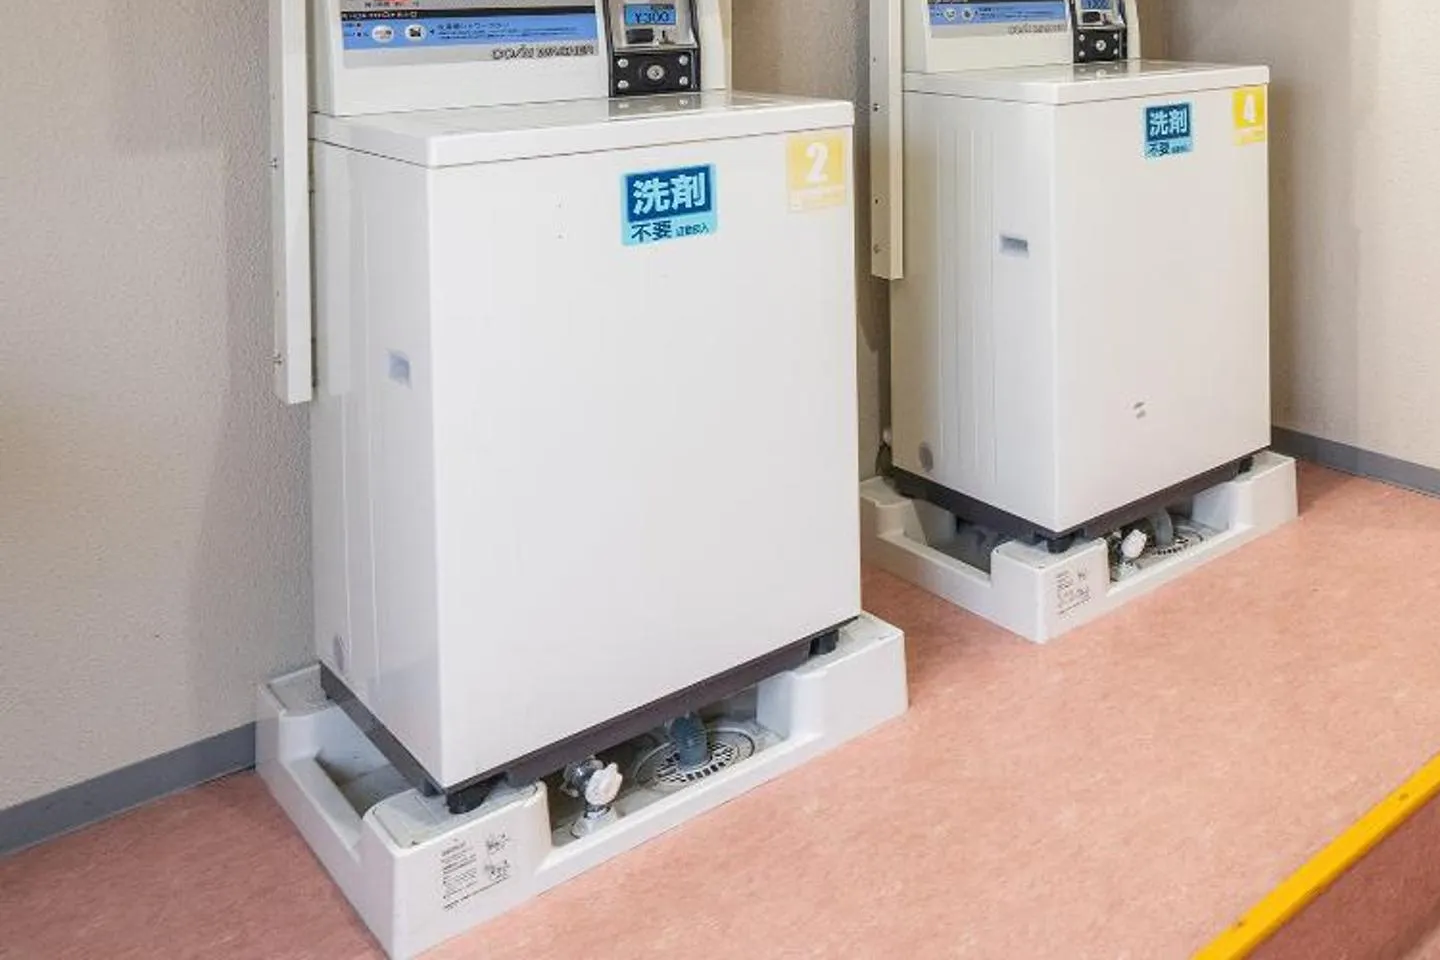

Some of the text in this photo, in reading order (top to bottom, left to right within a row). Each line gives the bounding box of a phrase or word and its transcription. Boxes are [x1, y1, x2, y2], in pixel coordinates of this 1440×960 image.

[1150, 108, 1188, 137] 洗剤
[804, 141, 829, 182] 2
[632, 171, 706, 215] 洗剤
[631, 220, 672, 242] 不要
